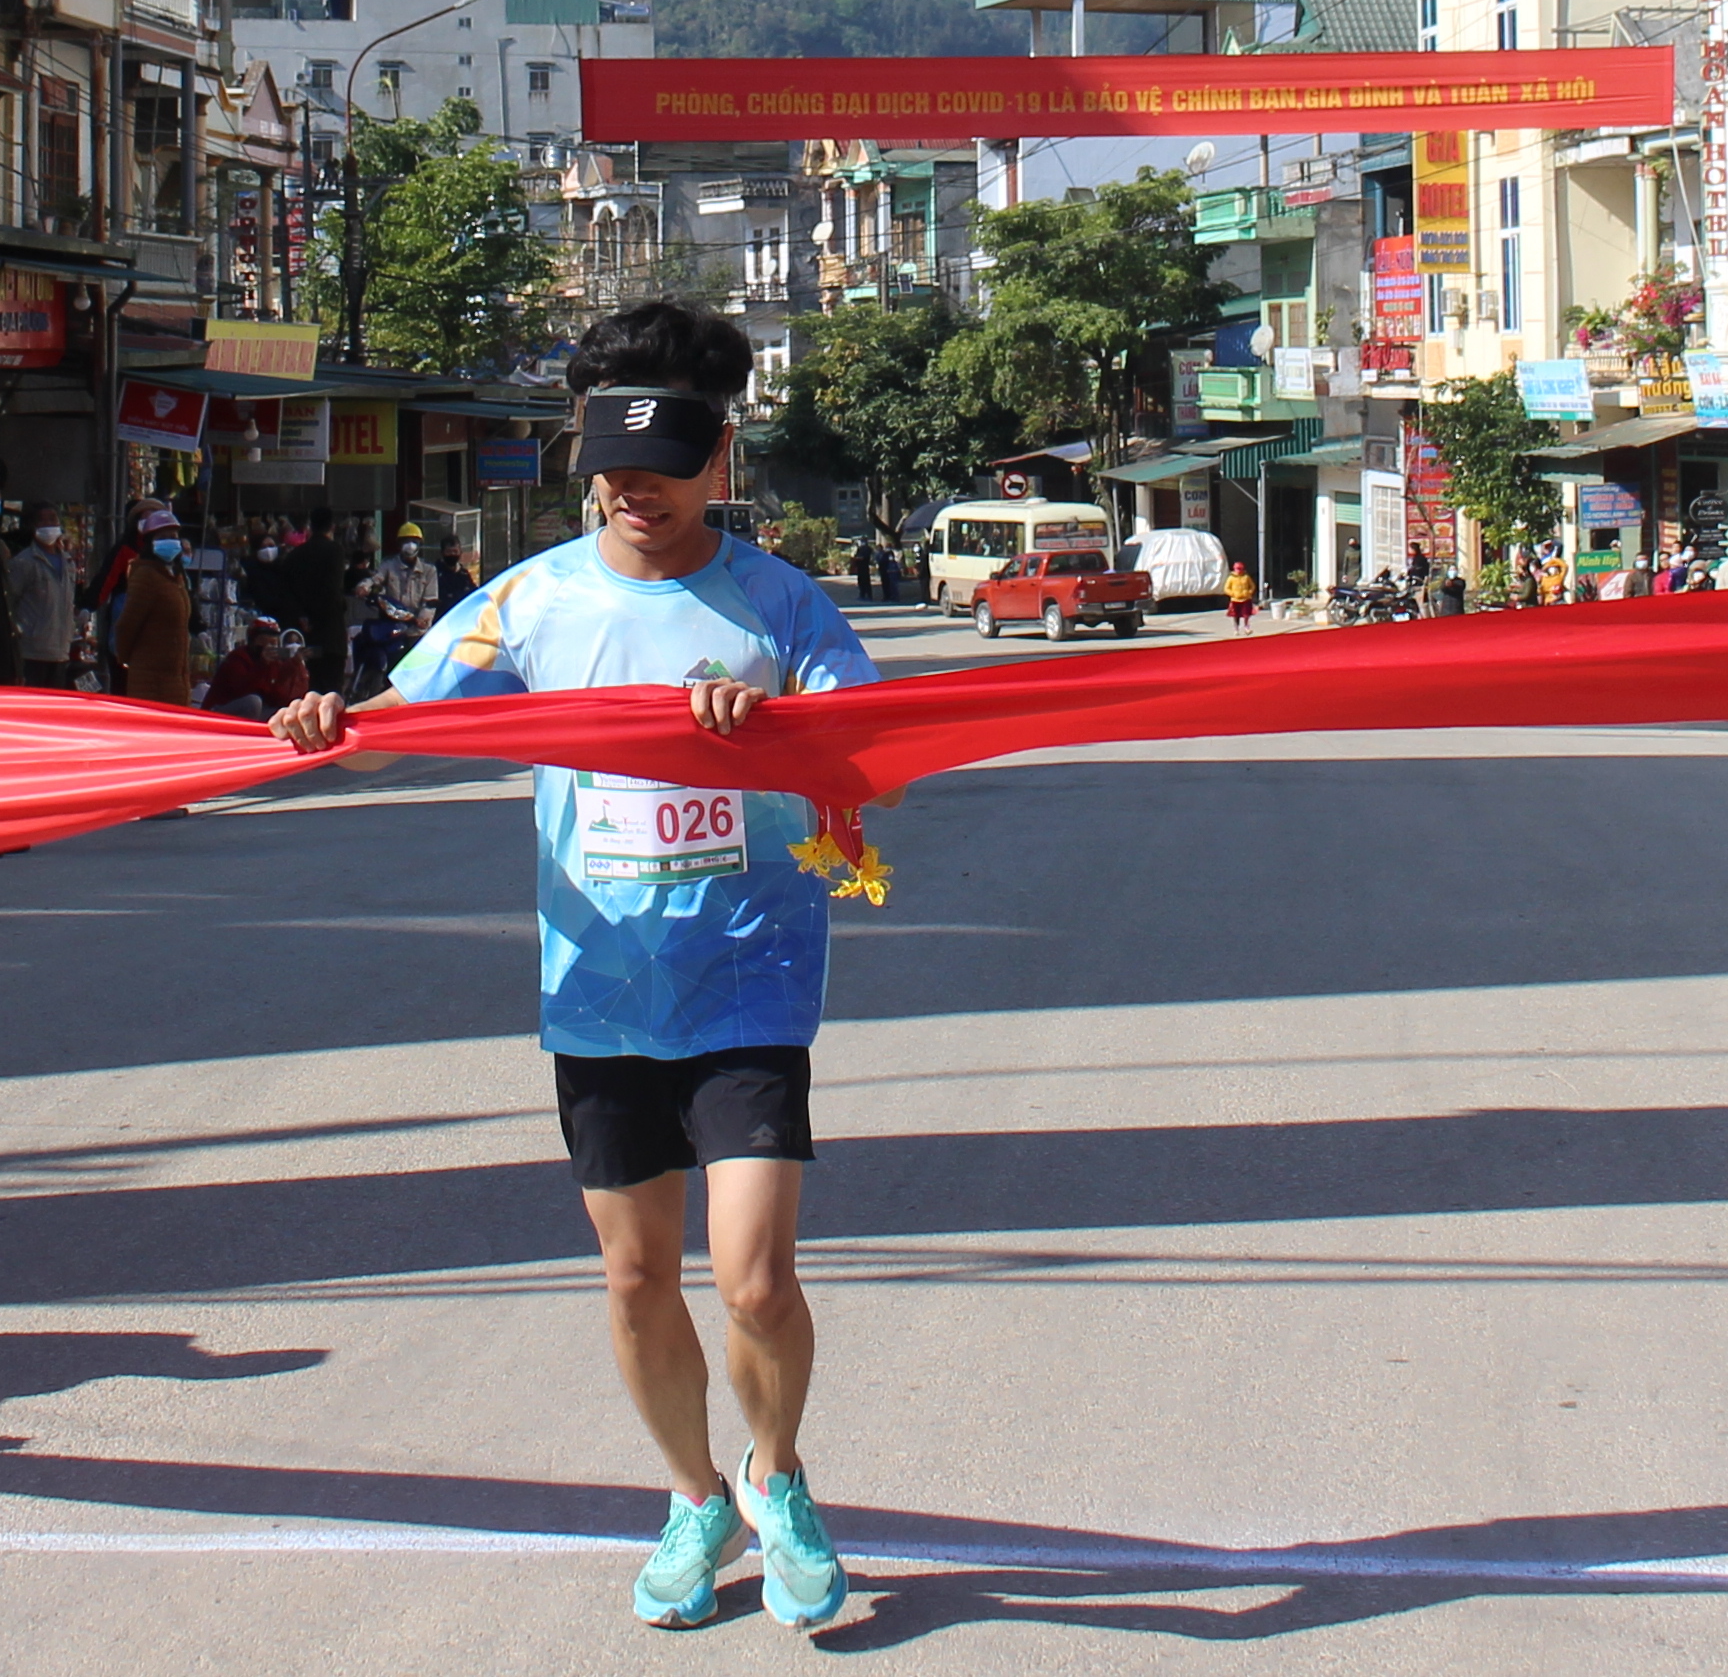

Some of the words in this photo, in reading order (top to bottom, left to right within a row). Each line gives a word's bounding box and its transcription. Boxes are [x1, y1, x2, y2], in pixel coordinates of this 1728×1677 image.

[655, 86, 742, 119] PHÒNG,
[747, 84, 826, 116] CHỐNG
[831, 92, 871, 119] ĐẠI
[877, 92, 931, 120] DỊCH
[1048, 86, 1073, 114] LÀ
[1083, 81, 1129, 114] BẢO
[1135, 84, 1164, 117] VỆ
[1172, 84, 1242, 112] CHÍNH
[1348, 80, 1405, 109] ĐÌNH
[1413, 78, 1443, 107] VÀ
[1520, 77, 1551, 103] XÃ
[1557, 75, 1596, 105] HỘI
[1418, 183, 1469, 219] HOTEL
[1703, 142, 1728, 258] HOTEL
[656, 794, 734, 844] 026
